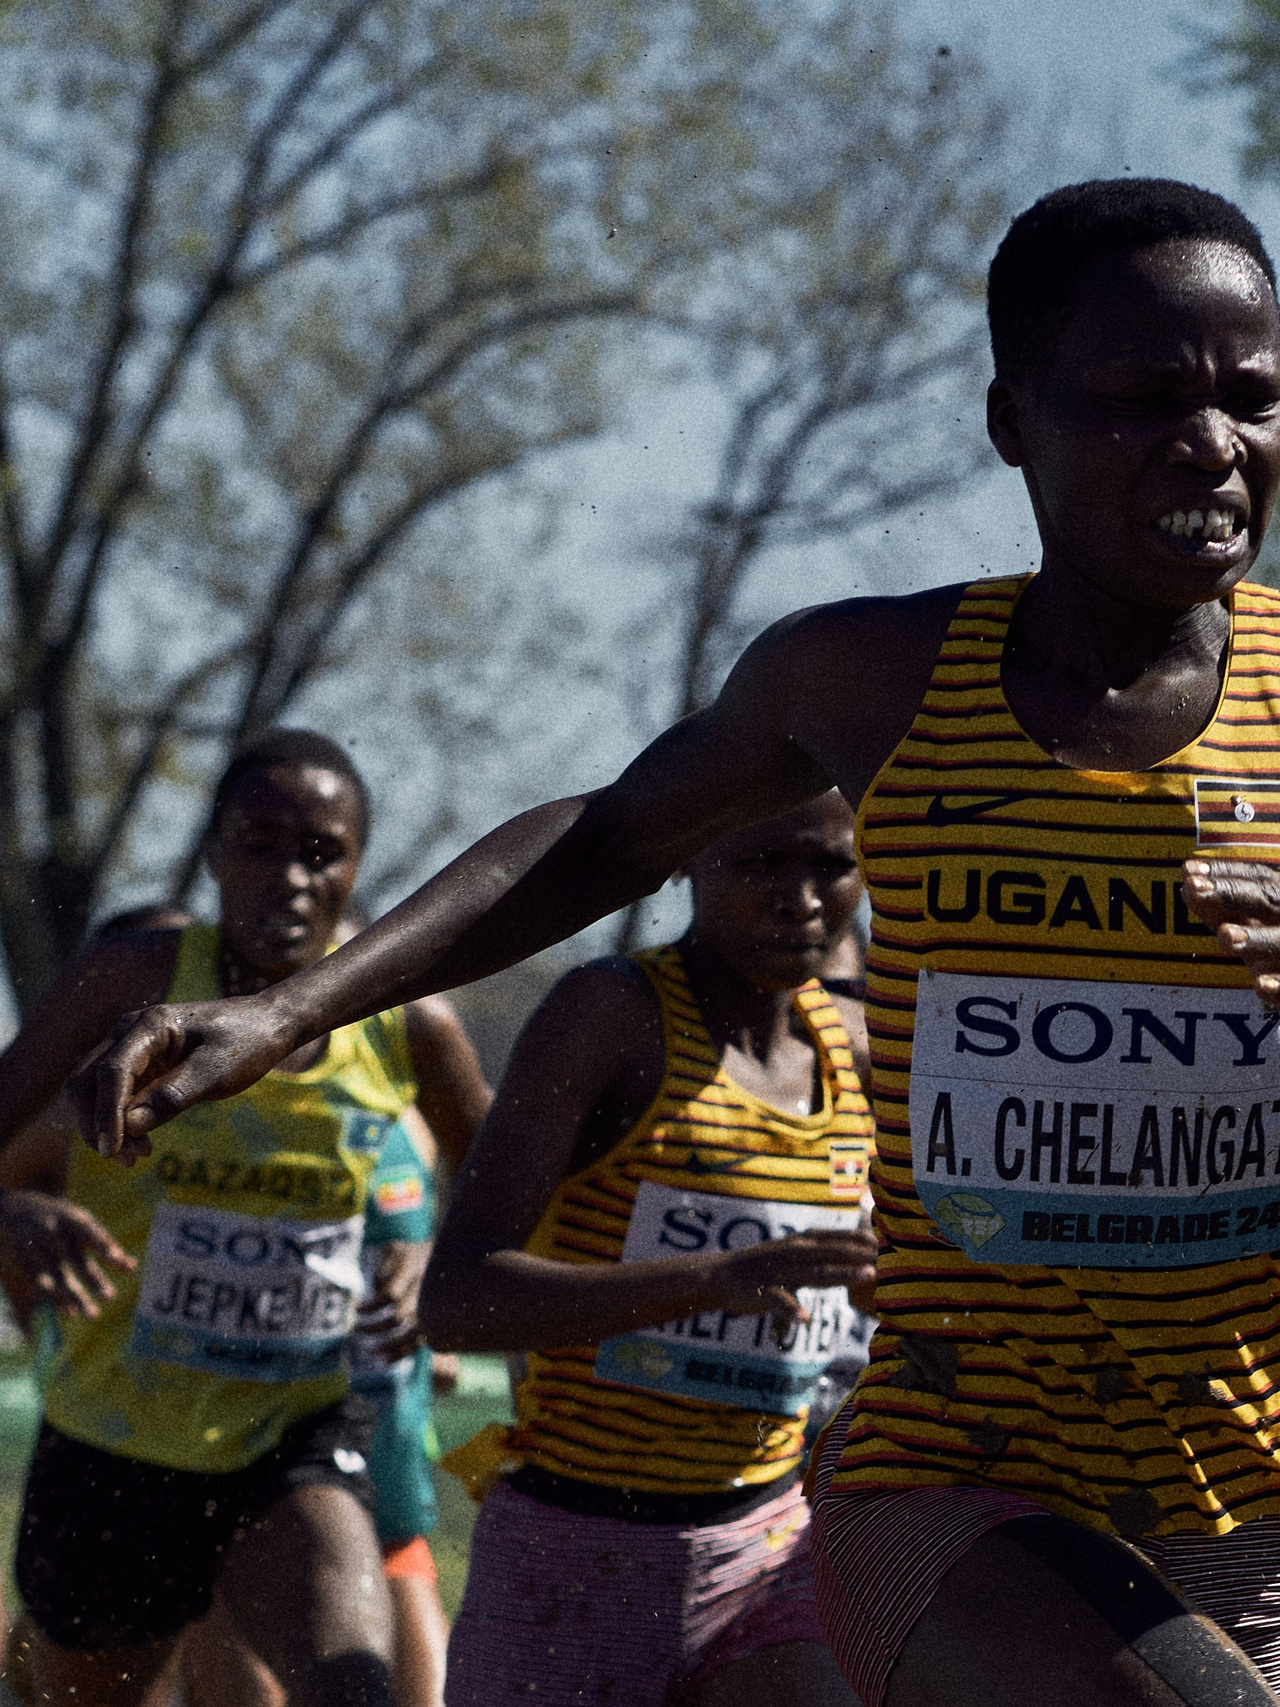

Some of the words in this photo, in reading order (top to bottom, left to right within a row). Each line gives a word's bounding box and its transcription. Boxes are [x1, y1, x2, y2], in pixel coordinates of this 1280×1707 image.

[926, 868, 1217, 936] UGAN
[925, 1091, 972, 1177] A.
[1020, 1210, 1231, 1245] BELGRADE
